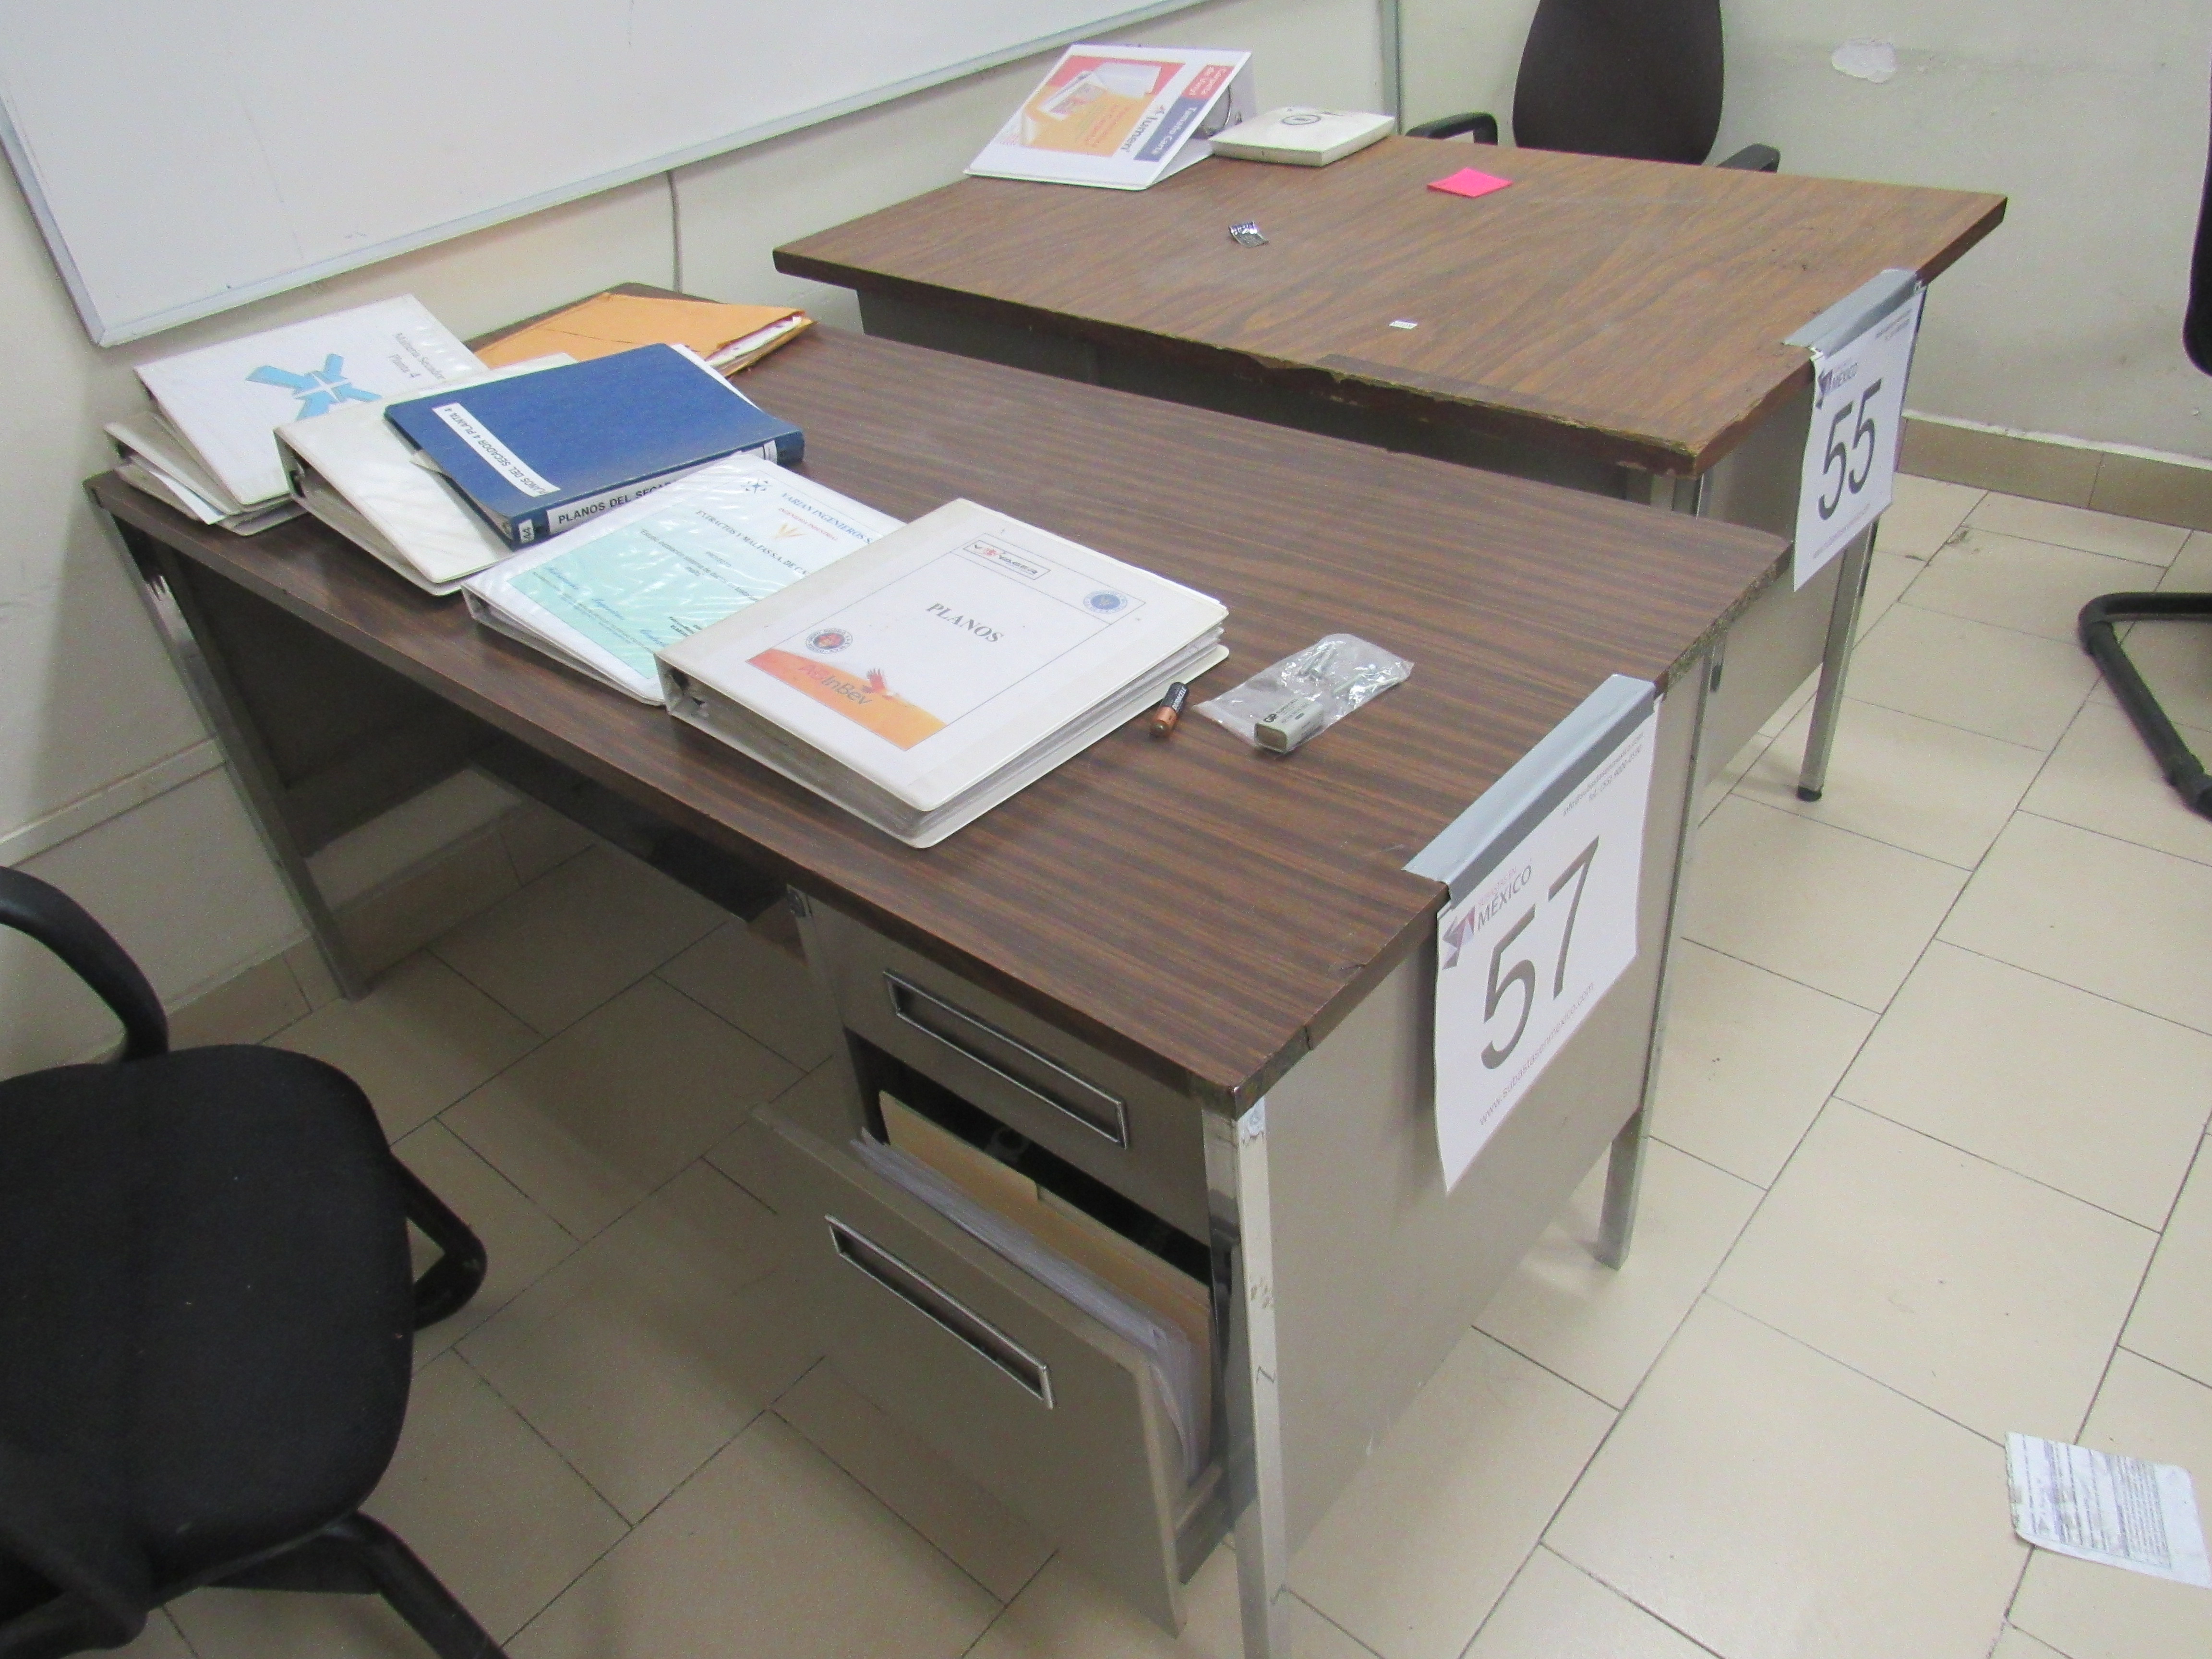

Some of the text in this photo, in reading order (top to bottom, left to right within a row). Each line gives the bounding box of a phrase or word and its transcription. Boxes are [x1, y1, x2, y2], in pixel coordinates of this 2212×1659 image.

[450, 412, 476, 435] PLANTA
[478, 439, 511, 467] SECADOR
[1818, 378, 1883, 520] 55
[508, 466, 525, 479] DEL
[558, 502, 605, 525] PLANOS
[609, 494, 633, 508] DEL
[781, 493, 814, 514] VARIAN
[814, 508, 866, 541] INGENIEROS
[696, 510, 736, 536] EXTRACTOS
[741, 535, 770, 555] MALTAS
[783, 559, 796, 569] DE
[926, 602, 1004, 643] PLANOS
[1172, 686, 1187, 711] DURACELL
[1481, 835, 1599, 1070] 57
[1479, 982, 1594, 1126] www.subastasenmexico.com
